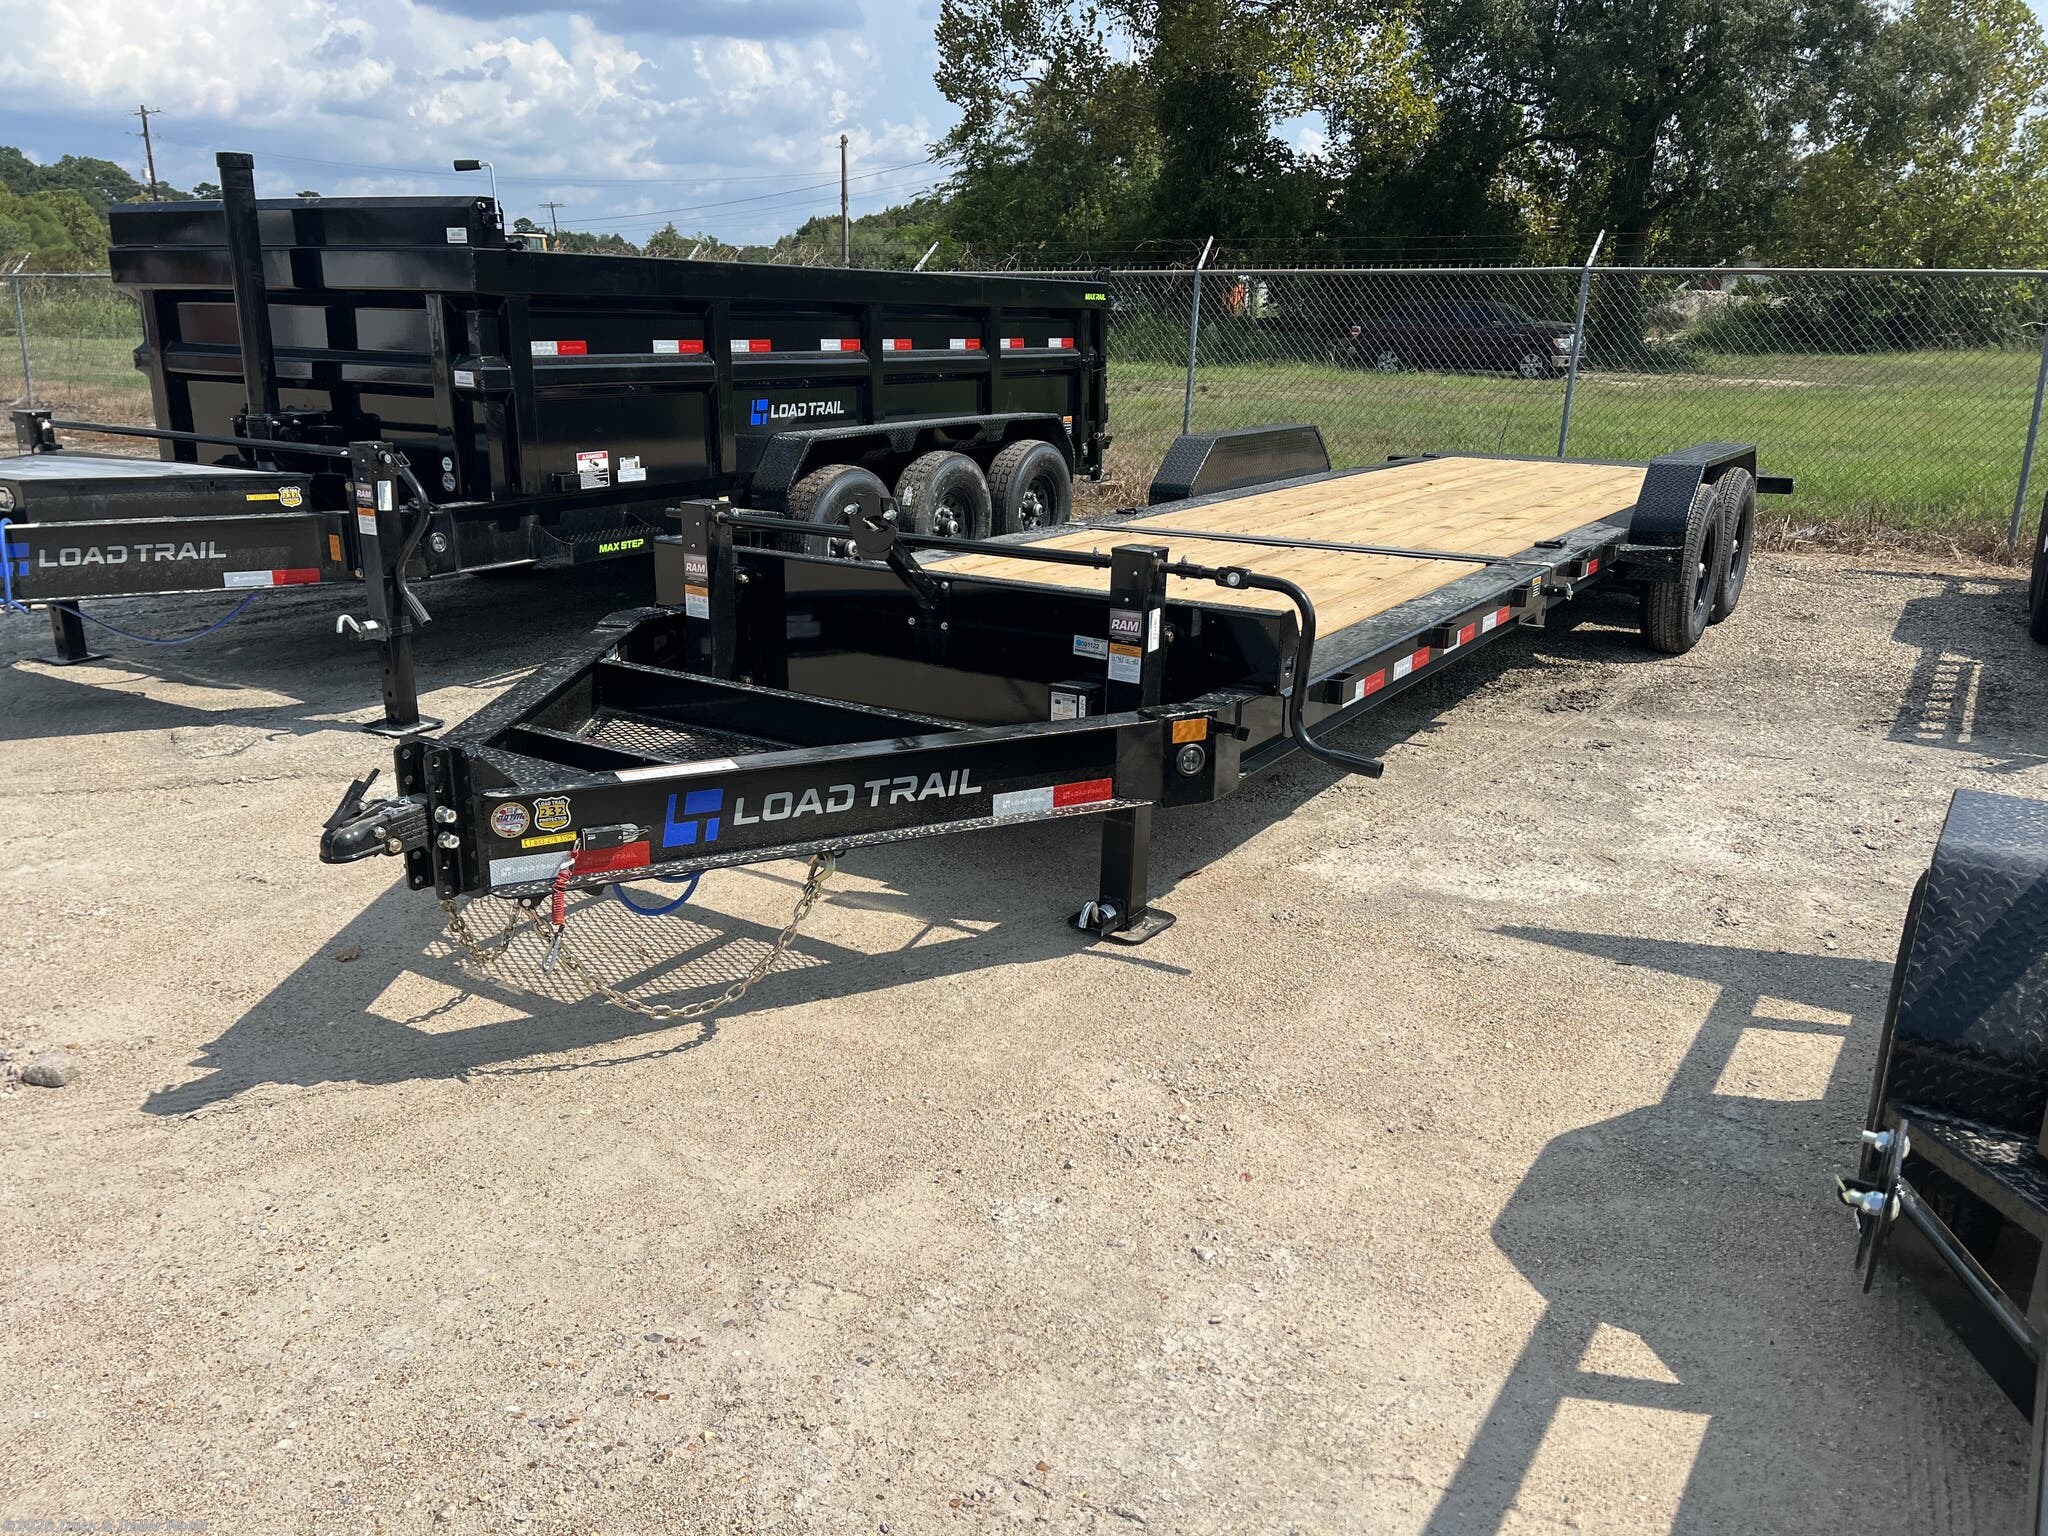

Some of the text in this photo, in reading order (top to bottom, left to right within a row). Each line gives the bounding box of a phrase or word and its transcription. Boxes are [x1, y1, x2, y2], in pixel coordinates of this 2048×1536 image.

[770, 400, 845, 419] LOAD TRAIL
[599, 538, 644, 553] MAX STEP
[38, 541, 227, 568] LOAD TRAIL
[685, 562, 706, 574] RAM
[1111, 618, 1139, 632] RAM
[733, 768, 982, 826] LOAD TRAIL
[541, 806, 564, 817] 232
